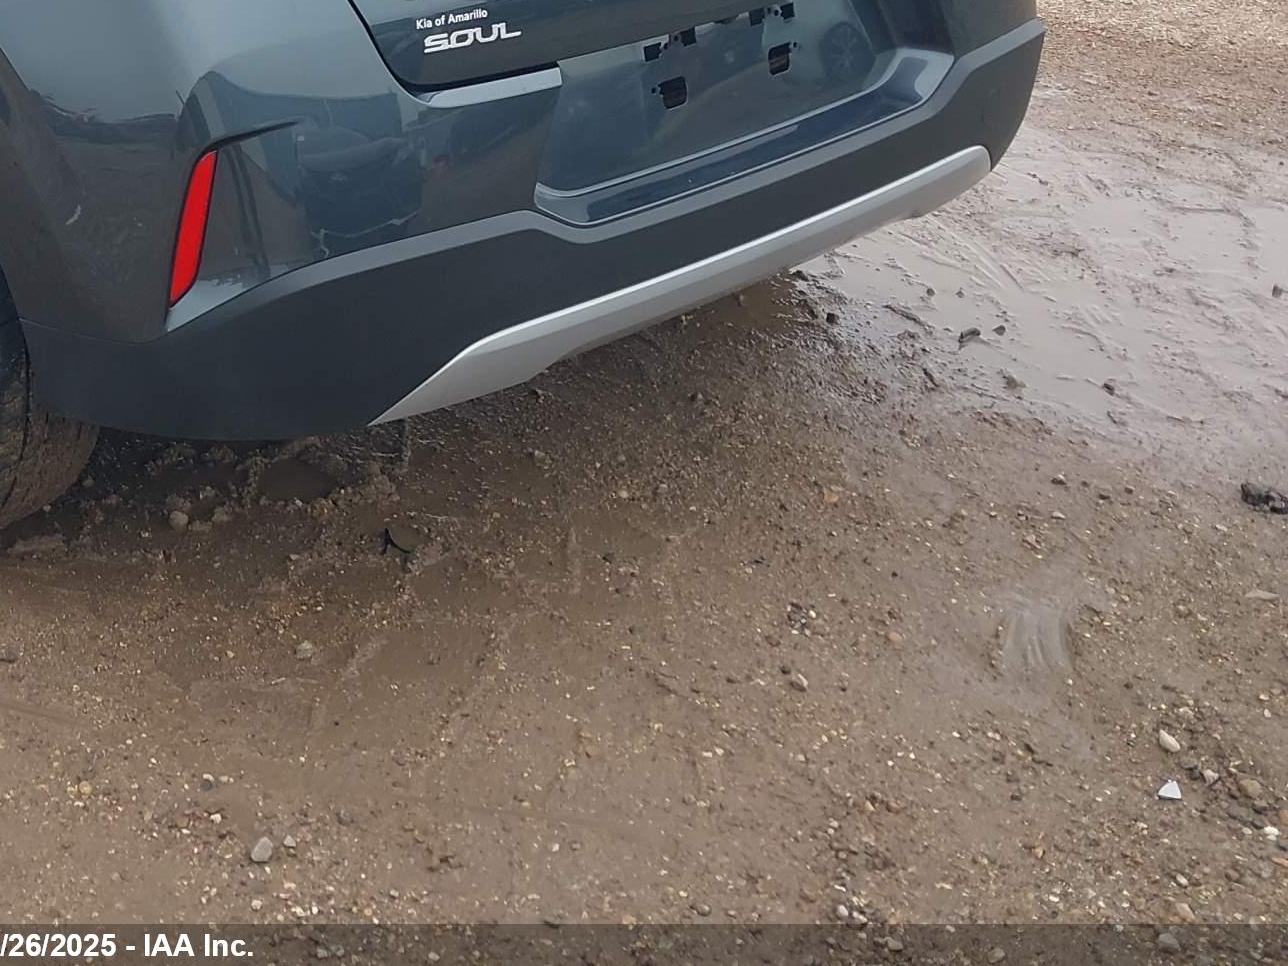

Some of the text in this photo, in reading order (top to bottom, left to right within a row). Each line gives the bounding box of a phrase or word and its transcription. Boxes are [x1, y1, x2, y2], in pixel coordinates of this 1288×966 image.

[416, 8, 488, 30] Kia of Amarillo
[423, 22, 522, 54] SOUL
